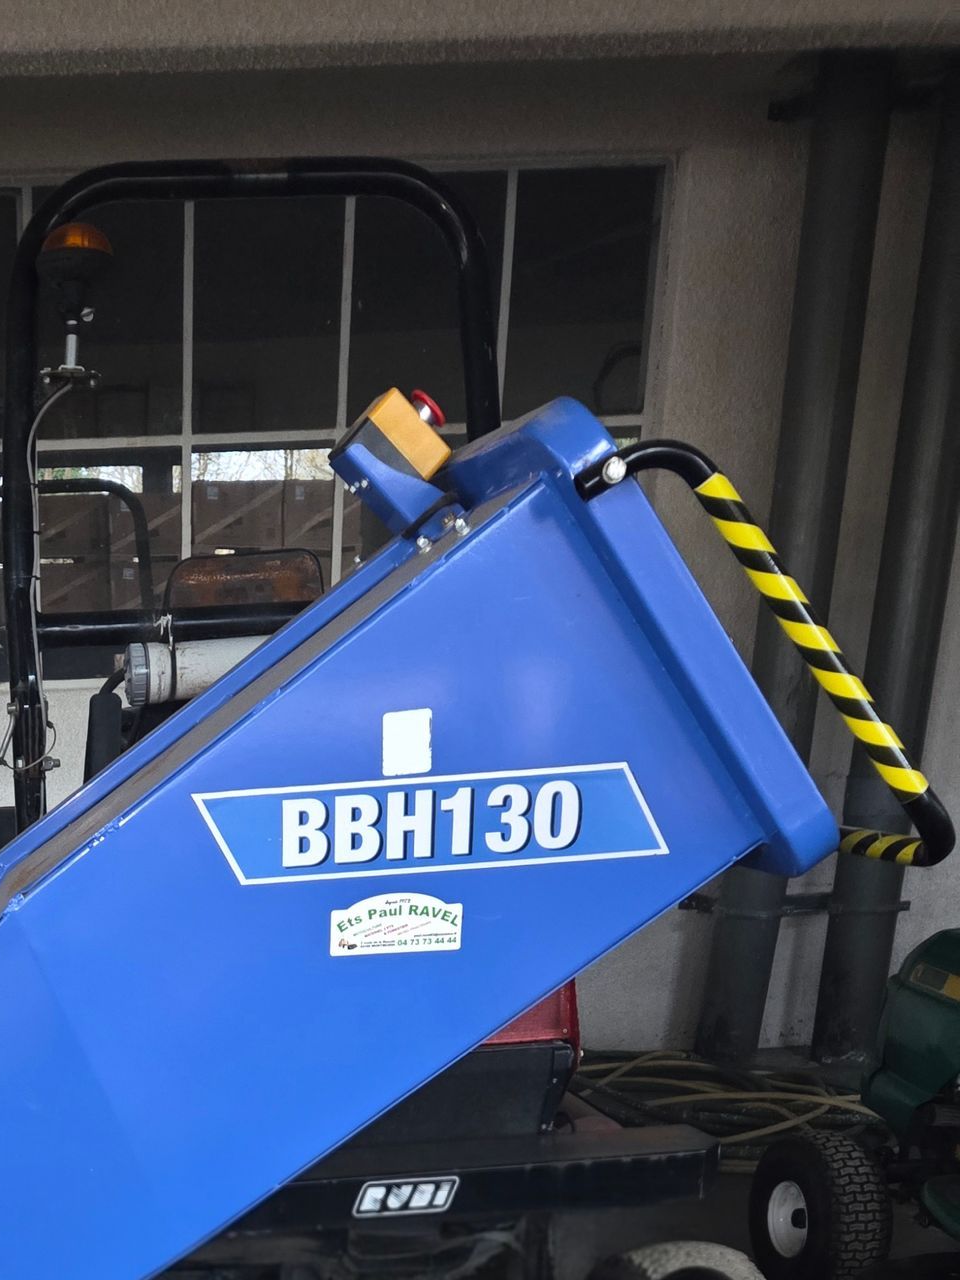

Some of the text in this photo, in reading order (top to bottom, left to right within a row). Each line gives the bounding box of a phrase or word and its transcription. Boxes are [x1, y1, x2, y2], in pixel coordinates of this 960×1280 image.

[281, 779, 581, 869] BBH130
[336, 916, 363, 933] Ets
[367, 904, 402, 920] Paul
[408, 904, 458, 927] RAVEL
[410, 938, 420, 946] 73
